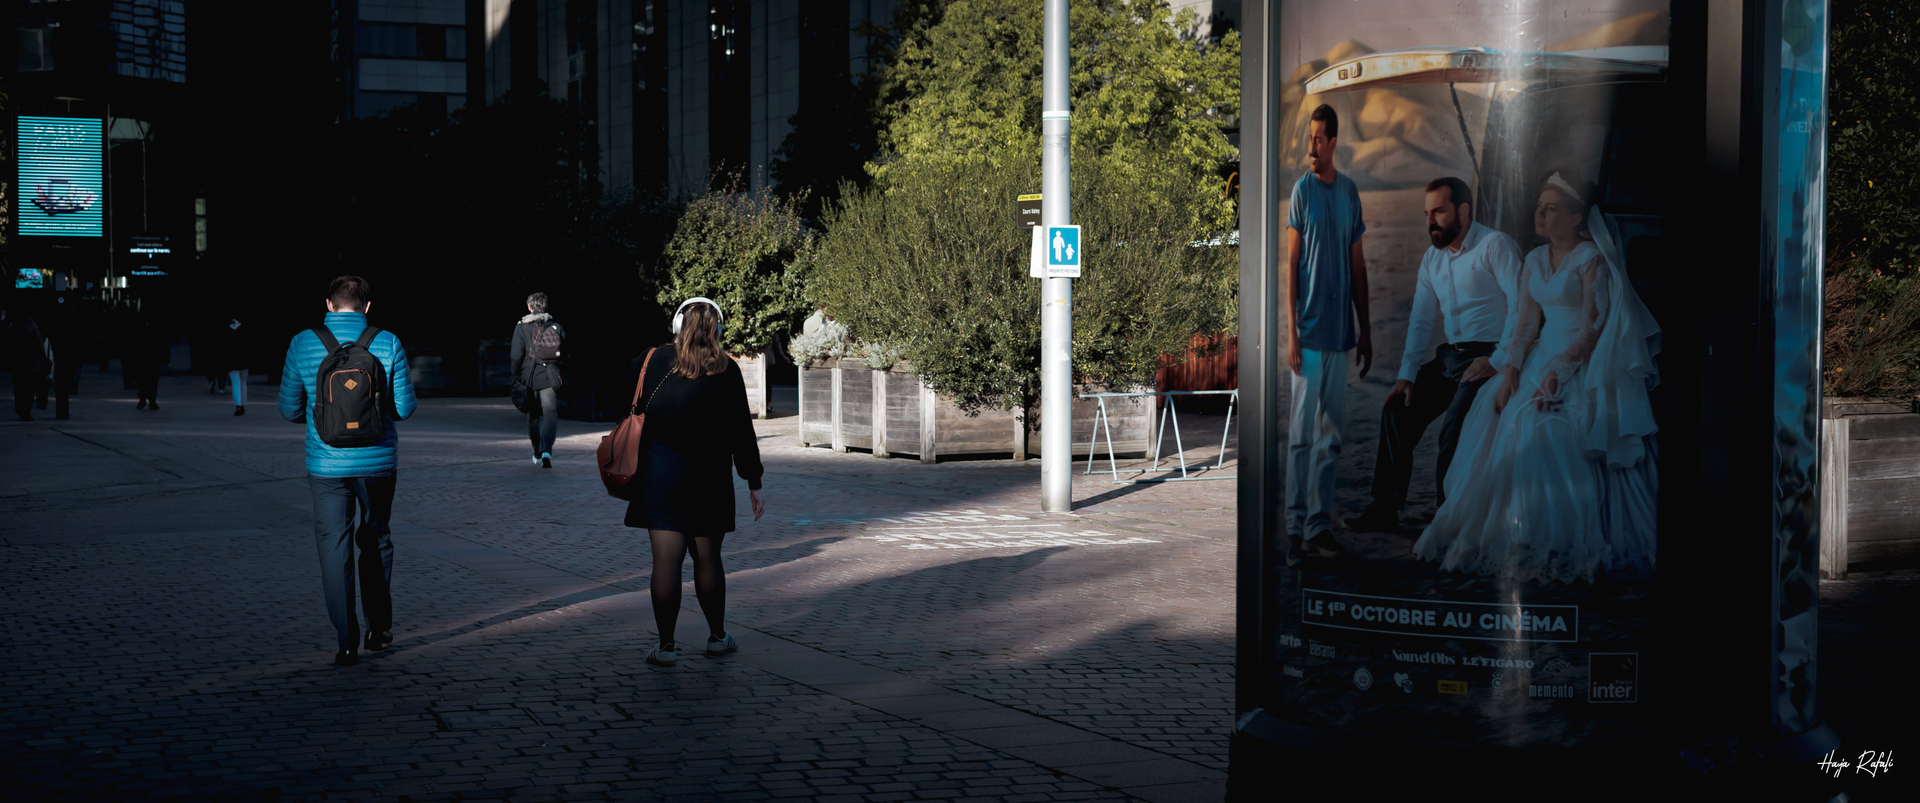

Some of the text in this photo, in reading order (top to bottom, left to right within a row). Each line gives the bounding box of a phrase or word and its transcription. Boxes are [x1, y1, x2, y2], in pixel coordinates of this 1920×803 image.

[1307, 598, 1324, 616] LE
[1350, 604, 1437, 627] OCTOBRE
[1442, 611, 1472, 629] AU
[1478, 610, 1568, 632] CINÉMA
[1280, 634, 1302, 648] arte
[1391, 648, 1430, 664] Nouvel
[1430, 651, 1456, 666] Obs
[1462, 656, 1480, 666] LE
[1479, 655, 1535, 669] FIGARO
[1528, 684, 1574, 698] memento
[1592, 681, 1633, 698] inter
